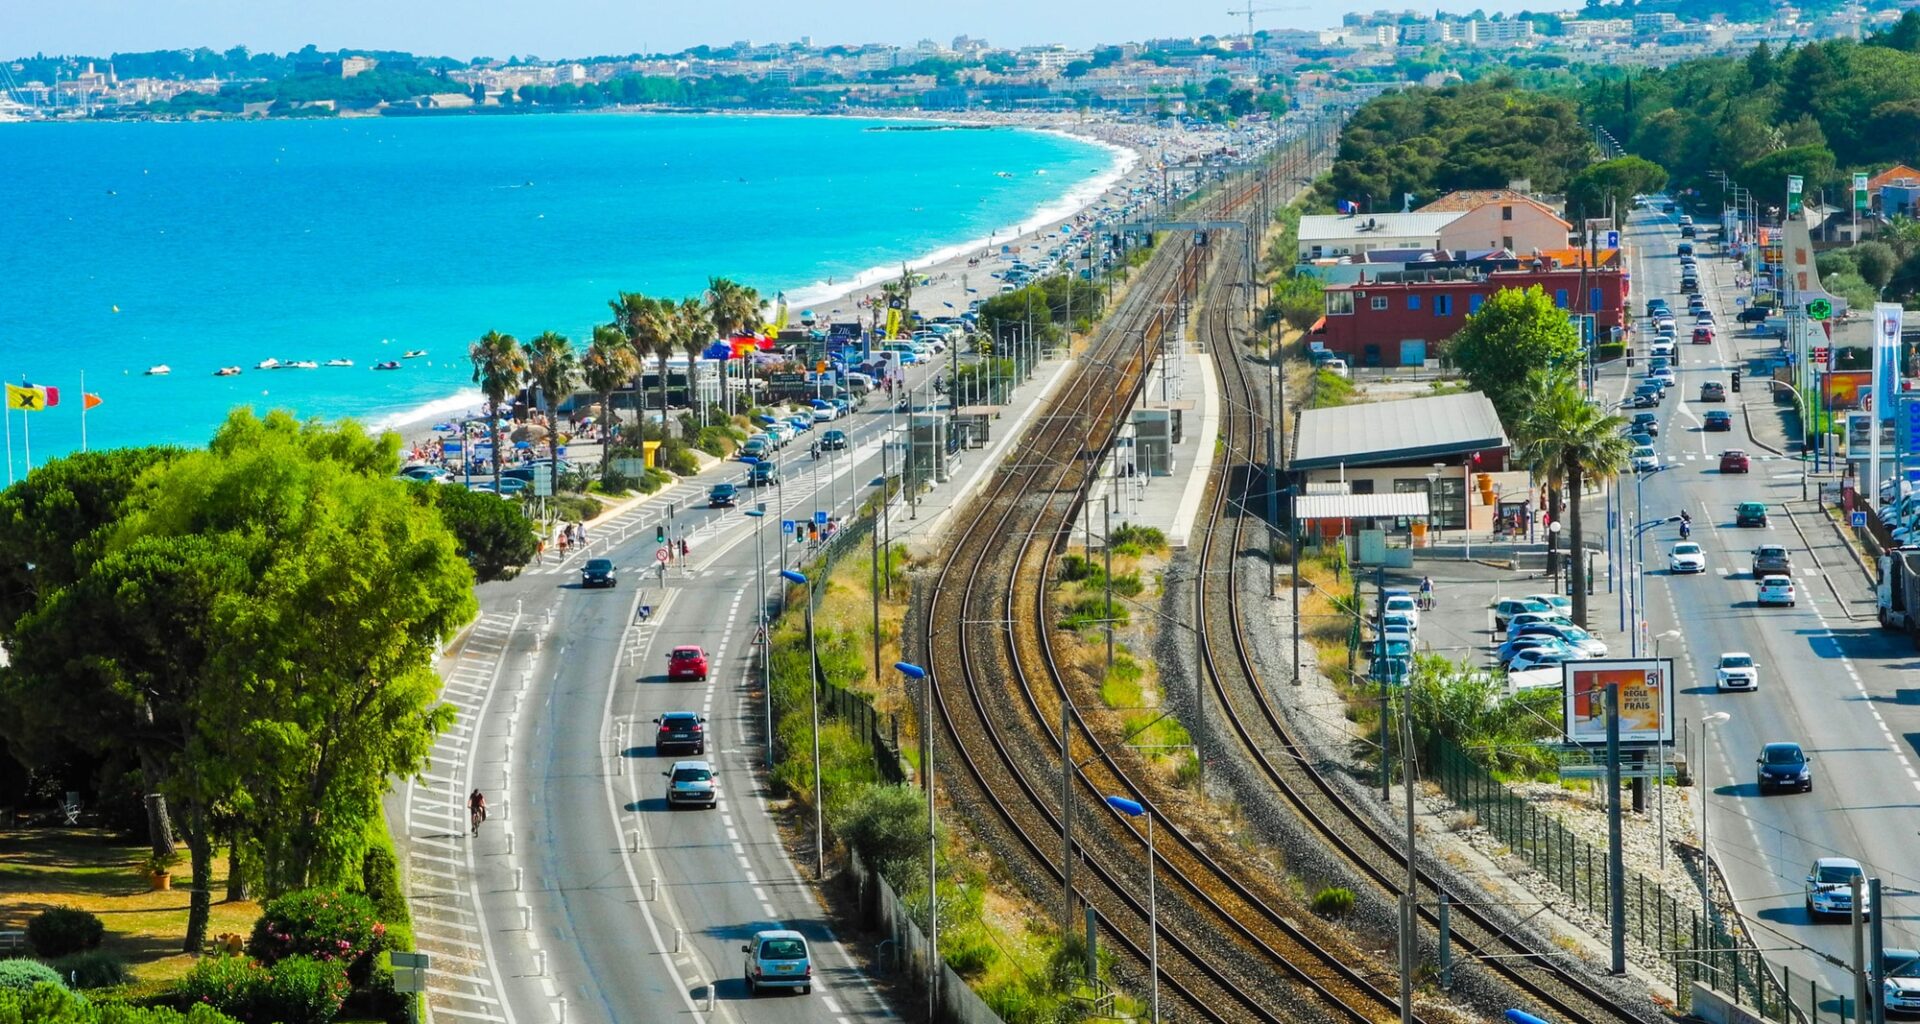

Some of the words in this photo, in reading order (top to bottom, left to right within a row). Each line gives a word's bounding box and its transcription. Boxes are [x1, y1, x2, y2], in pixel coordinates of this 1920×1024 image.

[1910, 403, 1920, 451] IVECO
[1647, 673, 1658, 685] 51
[1624, 702, 1650, 710] FRAIS
